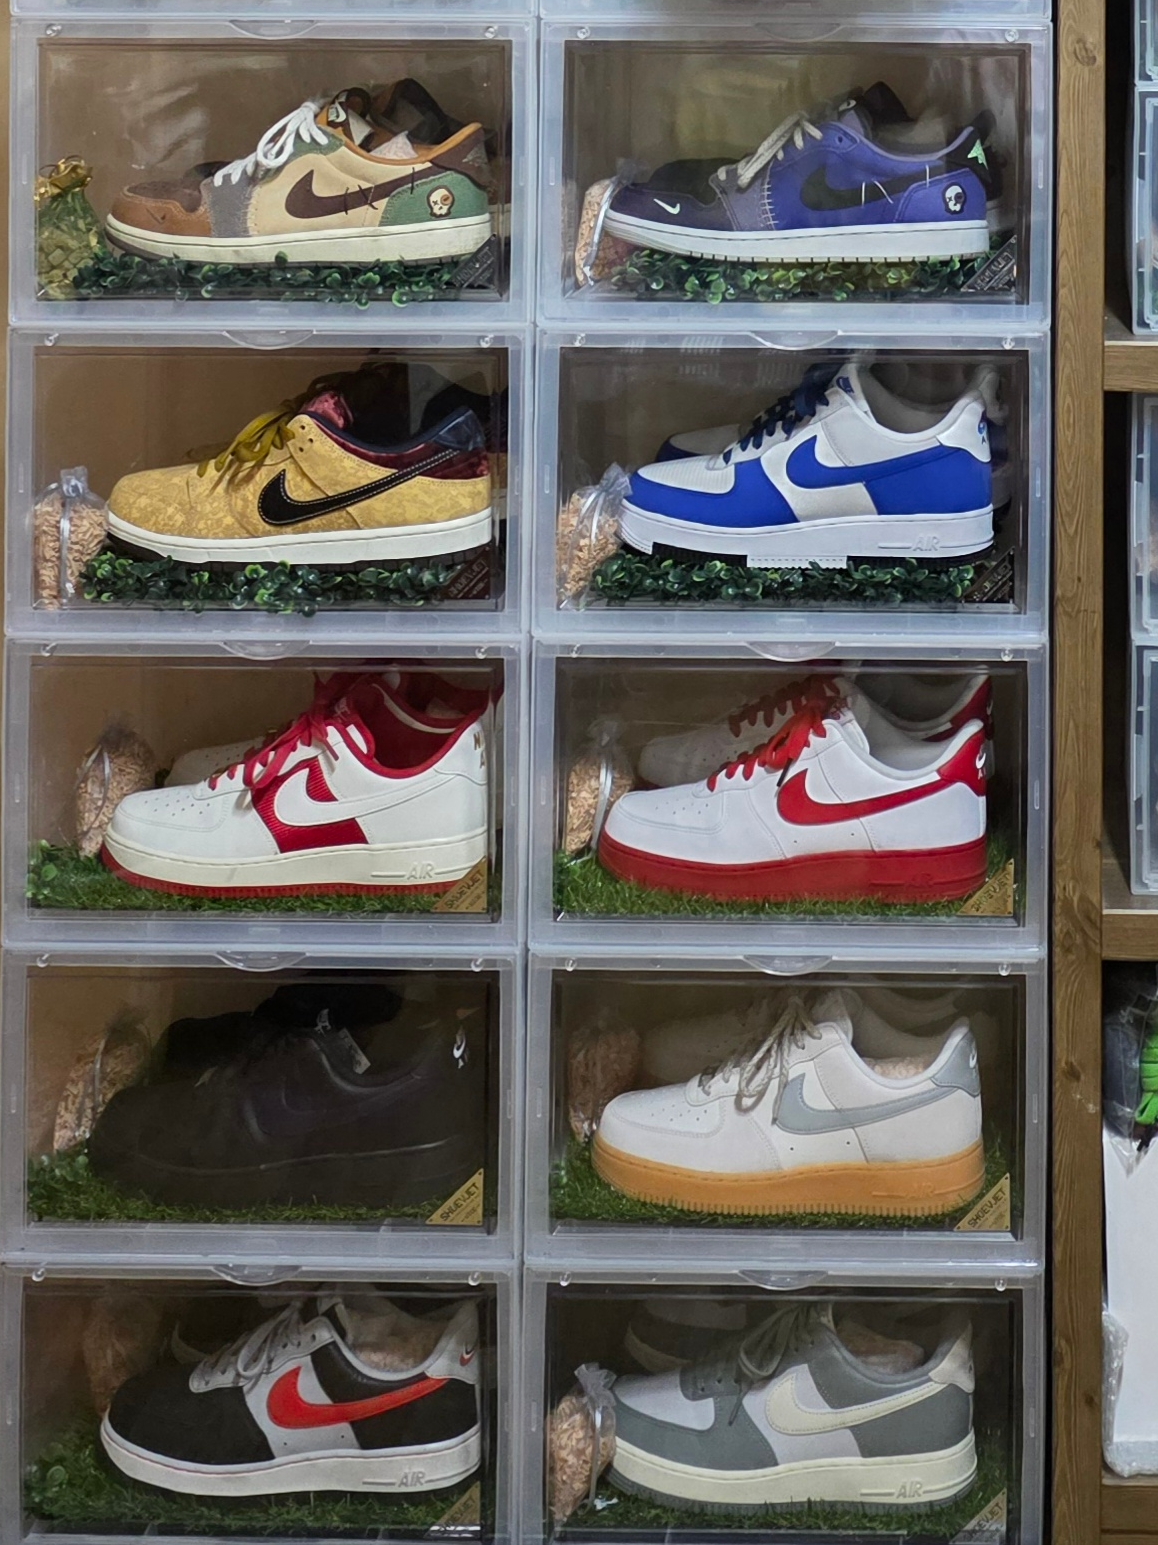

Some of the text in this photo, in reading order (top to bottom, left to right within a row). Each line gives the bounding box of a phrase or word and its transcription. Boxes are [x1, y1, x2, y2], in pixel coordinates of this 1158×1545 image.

[912, 535, 941, 552] AIR
[406, 862, 434, 881] AIR
[440, 1180, 480, 1222] SHOEVJET
[968, 1187, 1006, 1229] SHOEVJET
[397, 1469, 426, 1488] AIR
[896, 1479, 923, 1499] AIR
